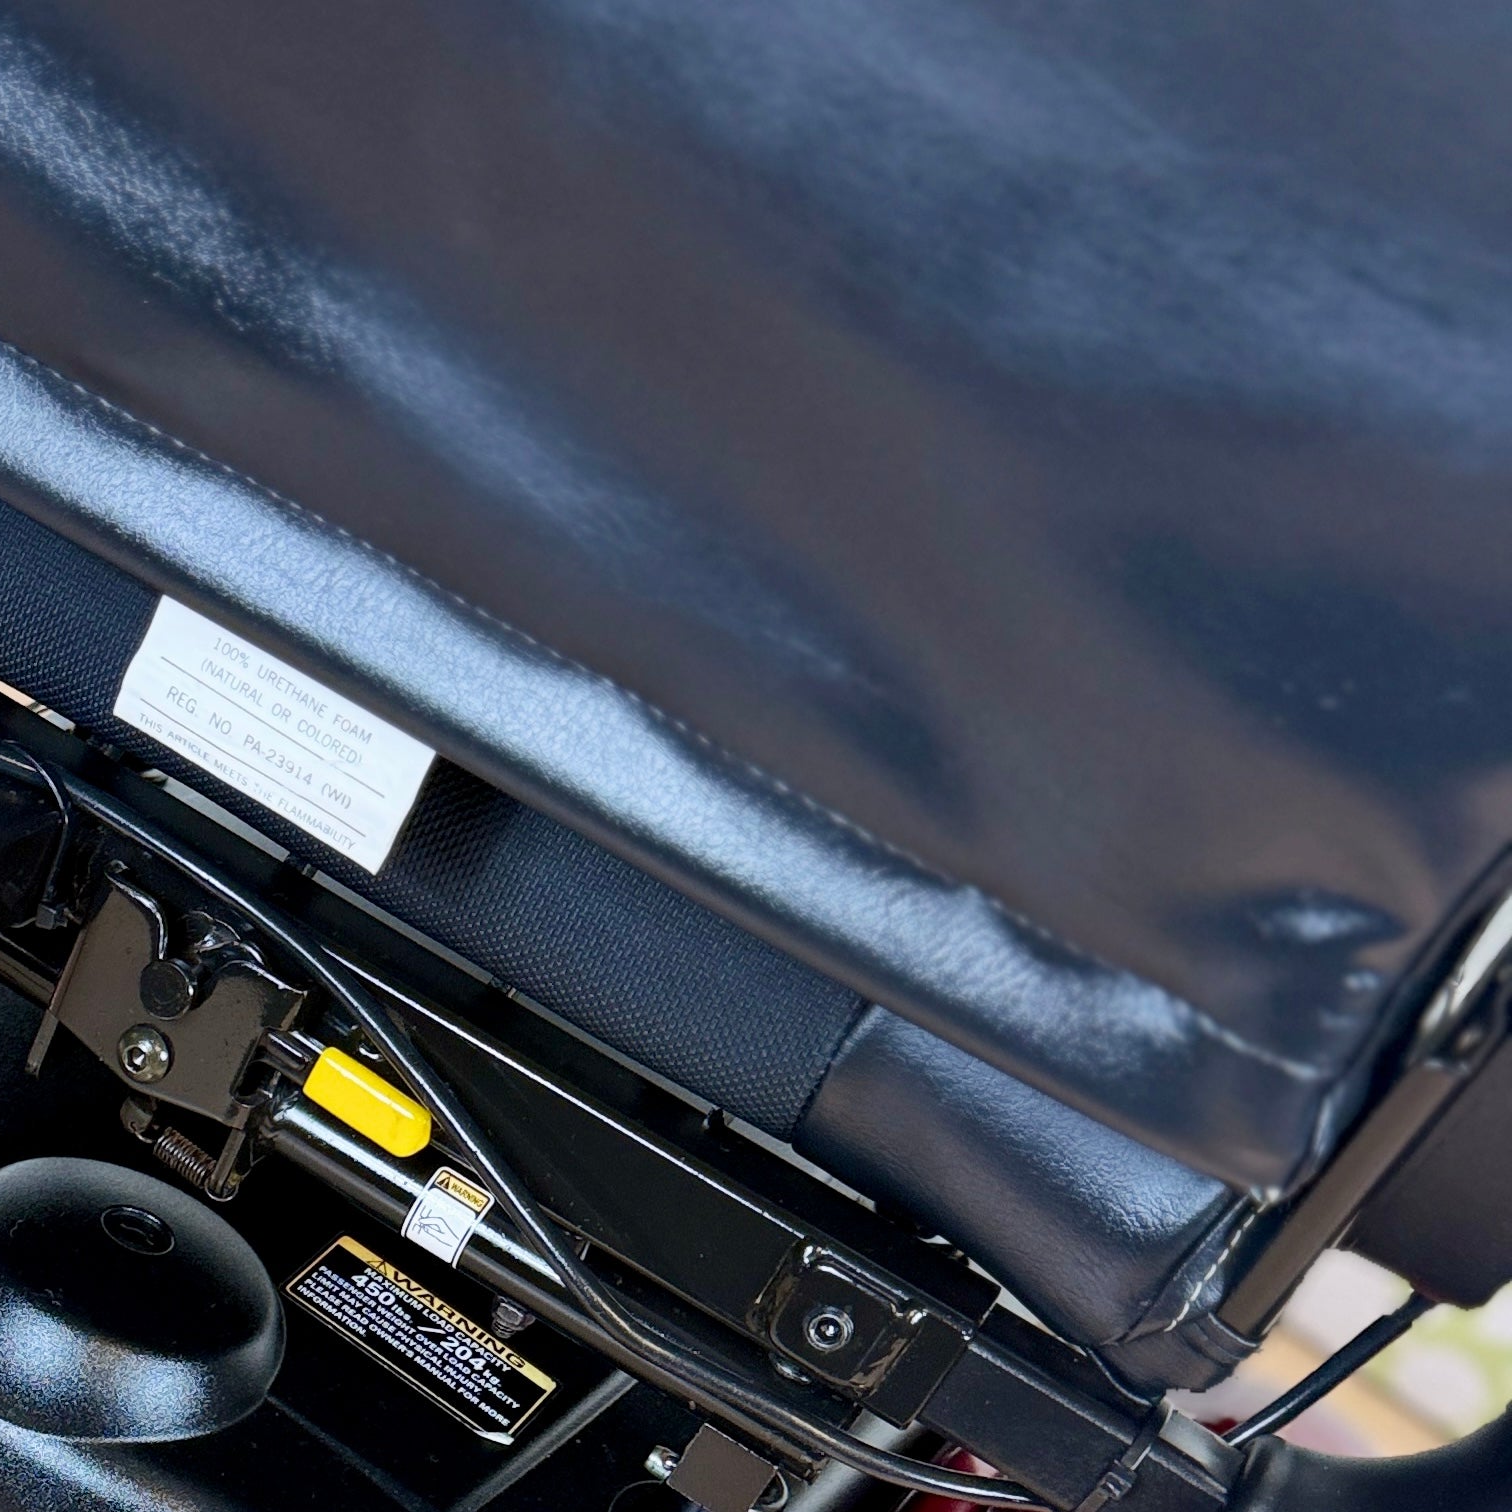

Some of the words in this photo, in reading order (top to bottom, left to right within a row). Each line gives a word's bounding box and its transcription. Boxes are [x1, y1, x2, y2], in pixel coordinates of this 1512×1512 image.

[200, 657, 263, 707] (NATURAL
[270, 702, 292, 723] OR
[212, 636, 250, 669] 100%
[256, 663, 328, 718] URETHANE
[331, 712, 373, 744] FOAM
[139, 711, 162, 733] THIS
[167, 730, 209, 761] ARTICLE
[213, 758, 247, 786] MEETS
[278, 797, 356, 850] FLAMMABILITY
[165, 684, 201, 718] REG.
[242, 733, 313, 786] PA-23914
[320, 782, 352, 809] (WI)
[451, 1183, 484, 1208] WARNING
[296, 1284, 366, 1337] INFORMATION.
[303, 1277, 343, 1306] PLEASE
[340, 1303, 369, 1325] READ
[368, 1322, 414, 1358] OWNER'S
[412, 1355, 456, 1390] MANUAL
[456, 1386, 480, 1404] FOR
[477, 1401, 510, 1426] MORE
[310, 1271, 340, 1292] LIMIT
[338, 1290, 363, 1308] MAY
[361, 1306, 397, 1333] CAUSE
[394, 1330, 442, 1368] PHYSICAL
[442, 1364, 482, 1395] INJURY.
[318, 1265, 377, 1308] PASSENGER
[375, 1304, 417, 1334] WEIGHT
[414, 1332, 444, 1355] OVER
[441, 1352, 471, 1374] LOAD
[470, 1372, 520, 1408] CAPACITY
[350, 1274, 396, 1306] 450
[439, 1335, 486, 1370] 204
[481, 1368, 501, 1387] kg.
[363, 1266, 424, 1310] MAXIMUM
[421, 1308, 455, 1333] LOAD
[454, 1331, 511, 1372] CAPACITY
[392, 1270, 525, 1368] WARNING
